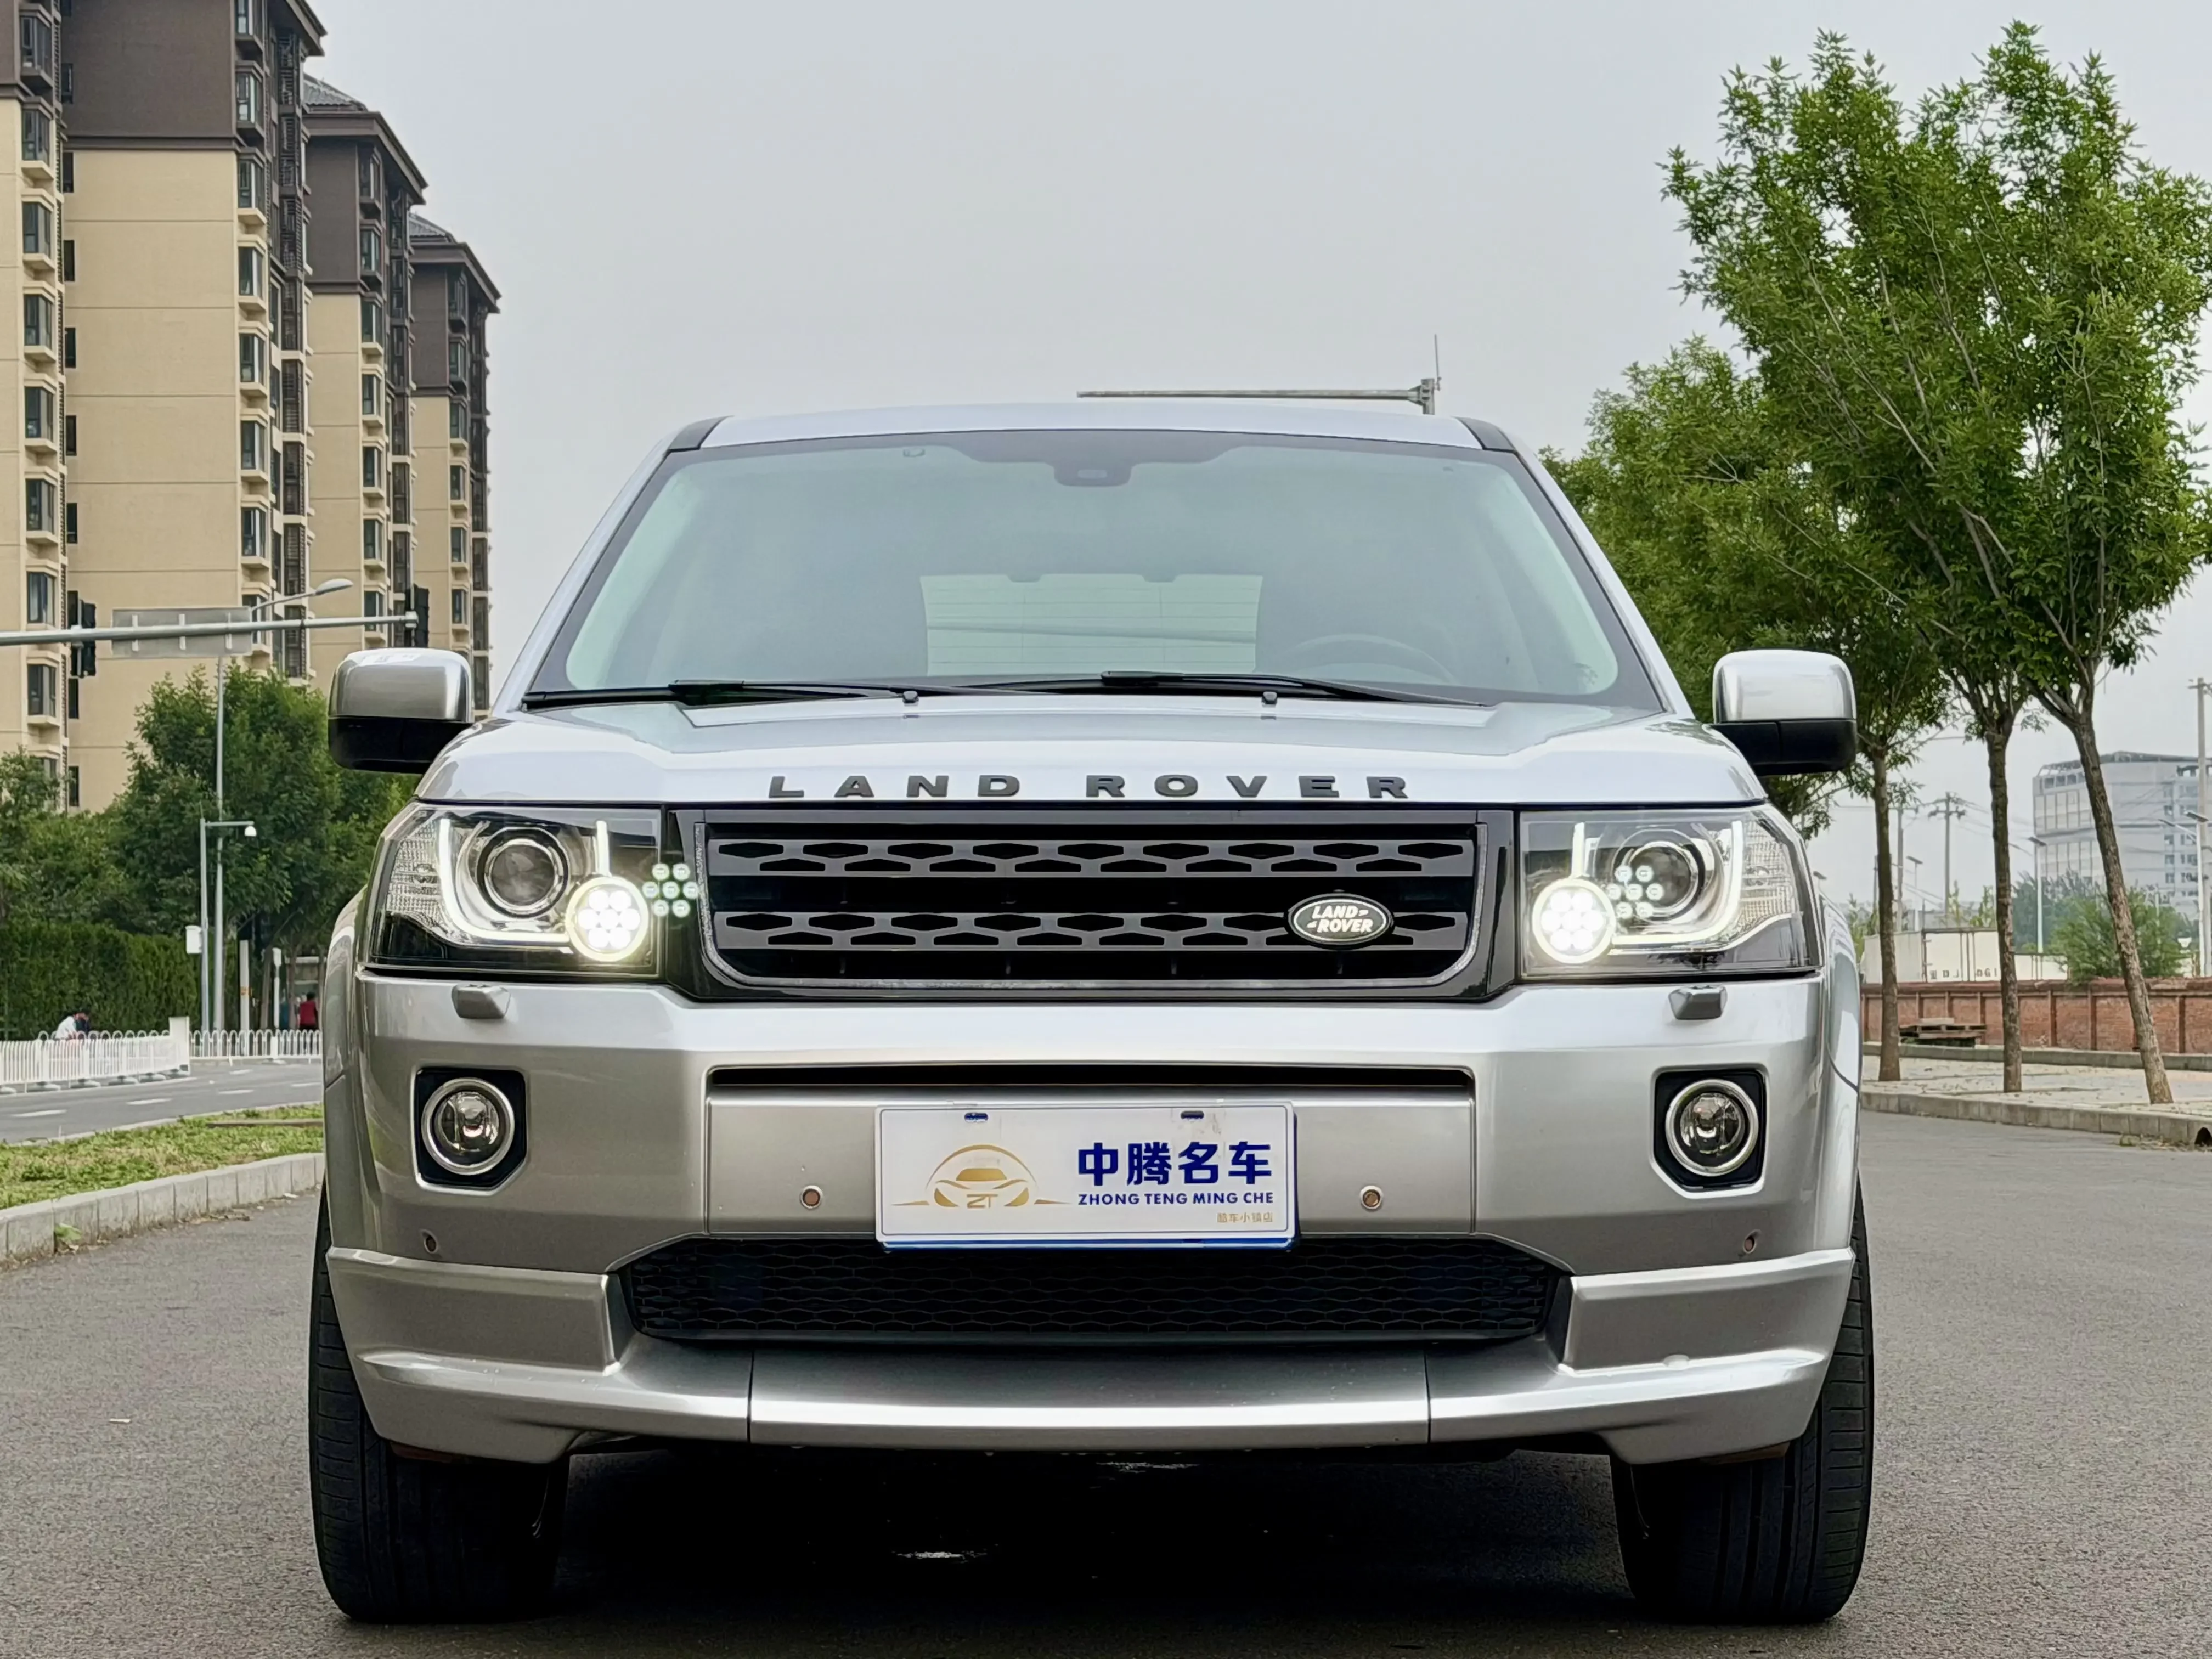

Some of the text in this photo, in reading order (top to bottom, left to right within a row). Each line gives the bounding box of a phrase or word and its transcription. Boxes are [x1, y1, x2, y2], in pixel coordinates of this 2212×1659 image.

[768, 774, 1408, 799] LAND ROVER
[1312, 905, 1358, 919] LAND
[1317, 919, 1373, 933] ROVER
[1077, 1141, 1272, 1186] 中腾名车
[1078, 1192, 1273, 1205] ZHONG TENG MING CHE
